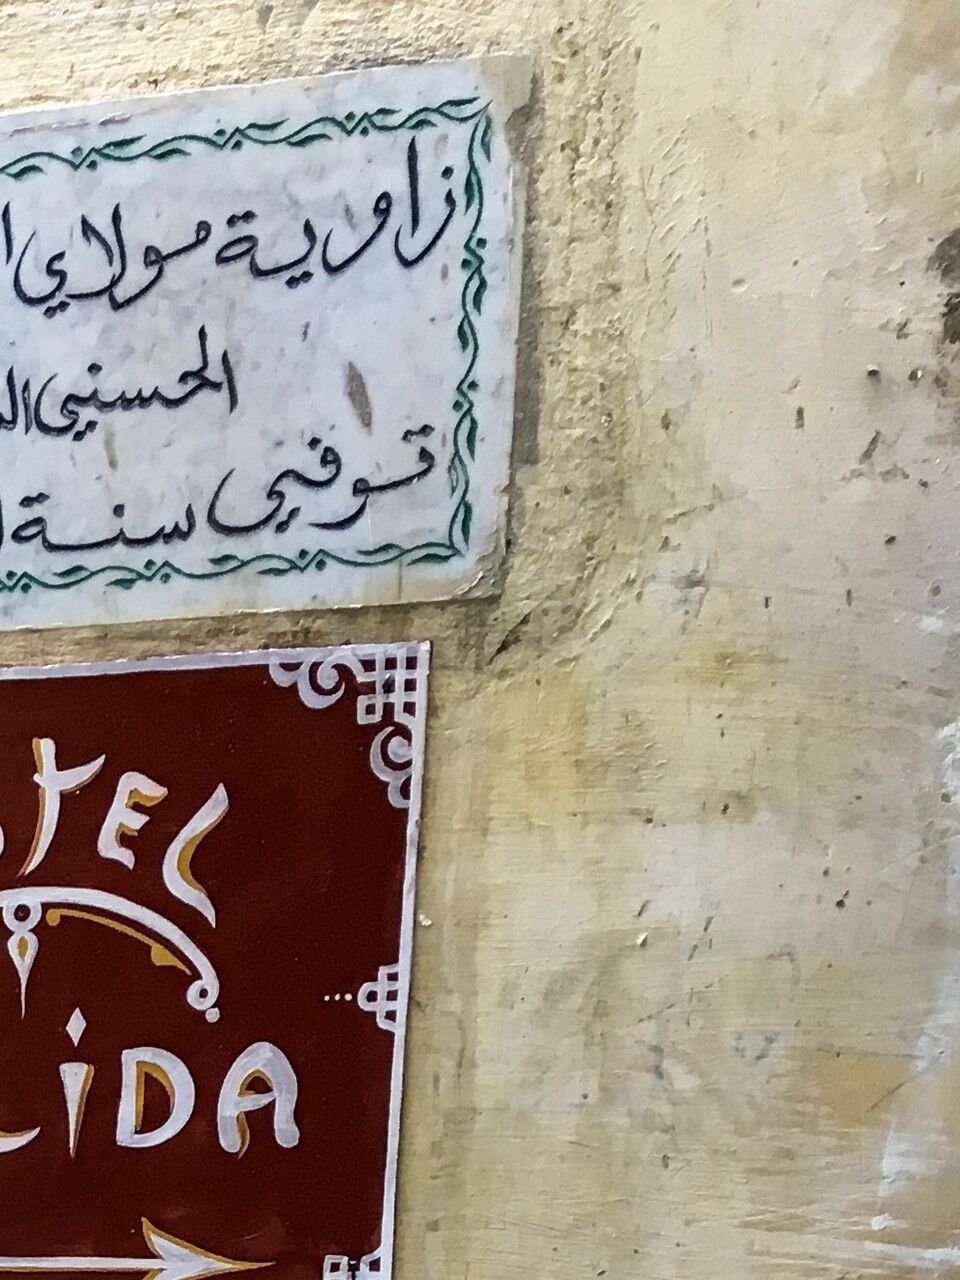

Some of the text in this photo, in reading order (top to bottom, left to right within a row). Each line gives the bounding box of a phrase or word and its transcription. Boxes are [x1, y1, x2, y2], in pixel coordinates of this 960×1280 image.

[13, 201, 212, 317] مولاي
[215, 135, 457, 289] زاوية
[34, 324, 239, 442] الحسني
[10, 491, 197, 553] سنة
[206, 424, 436, 536] توفي
